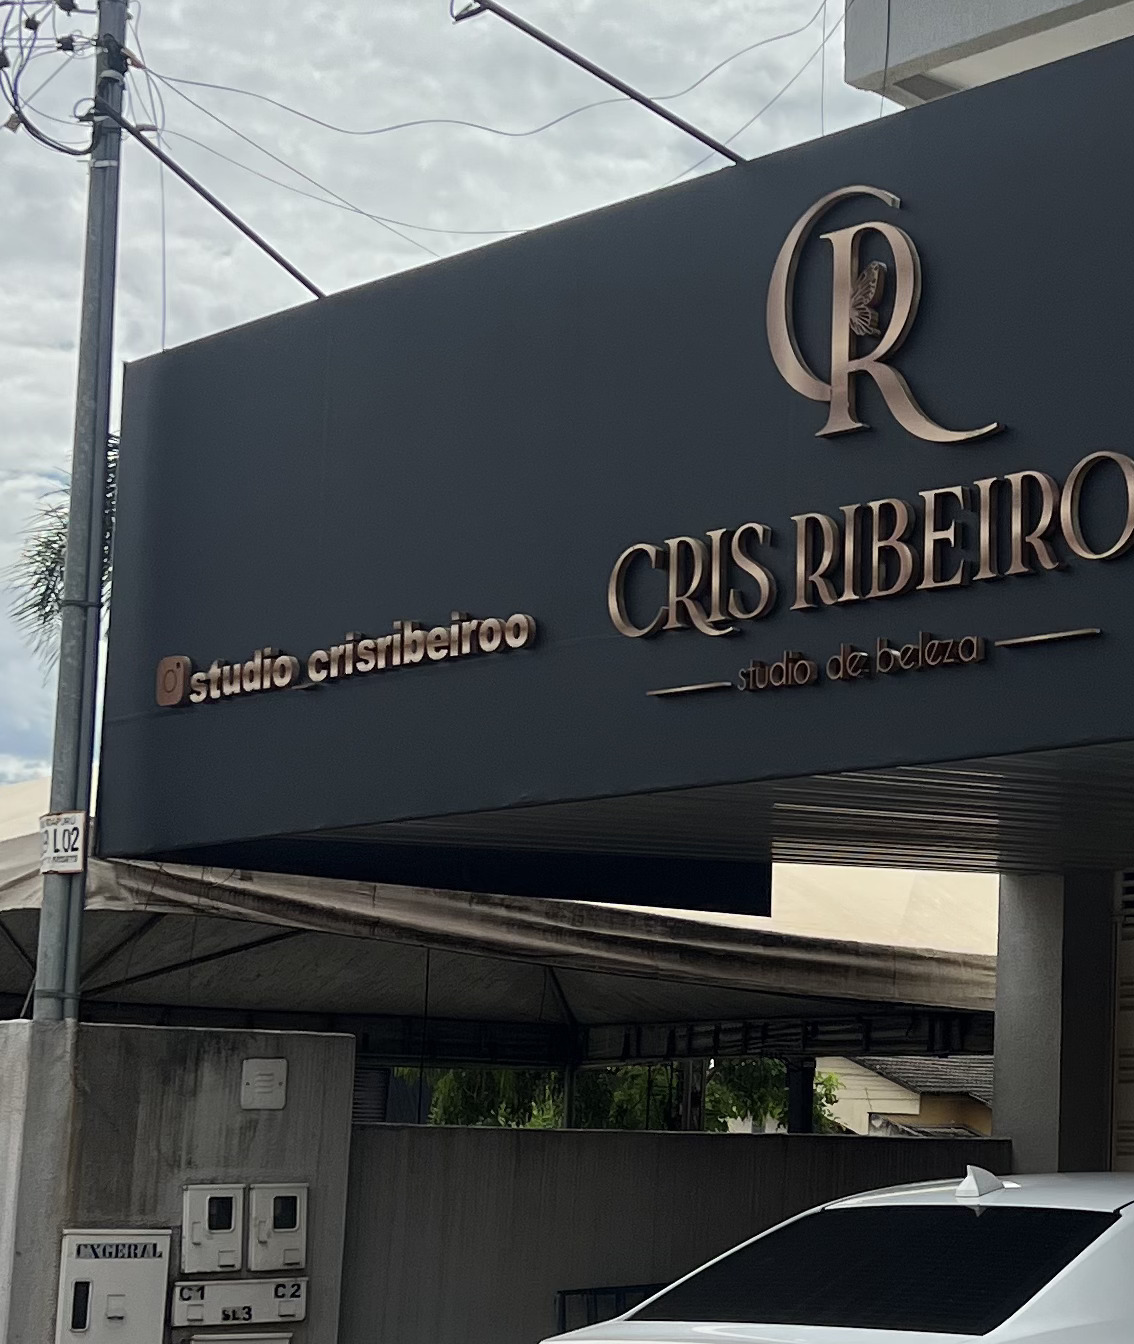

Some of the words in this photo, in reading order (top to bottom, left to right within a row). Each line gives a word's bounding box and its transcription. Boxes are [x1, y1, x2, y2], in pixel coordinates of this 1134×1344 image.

[607, 521, 776, 638] CRIS
[737, 650, 817, 691] studio
[826, 643, 868, 680] de
[876, 631, 985, 673] beleza
